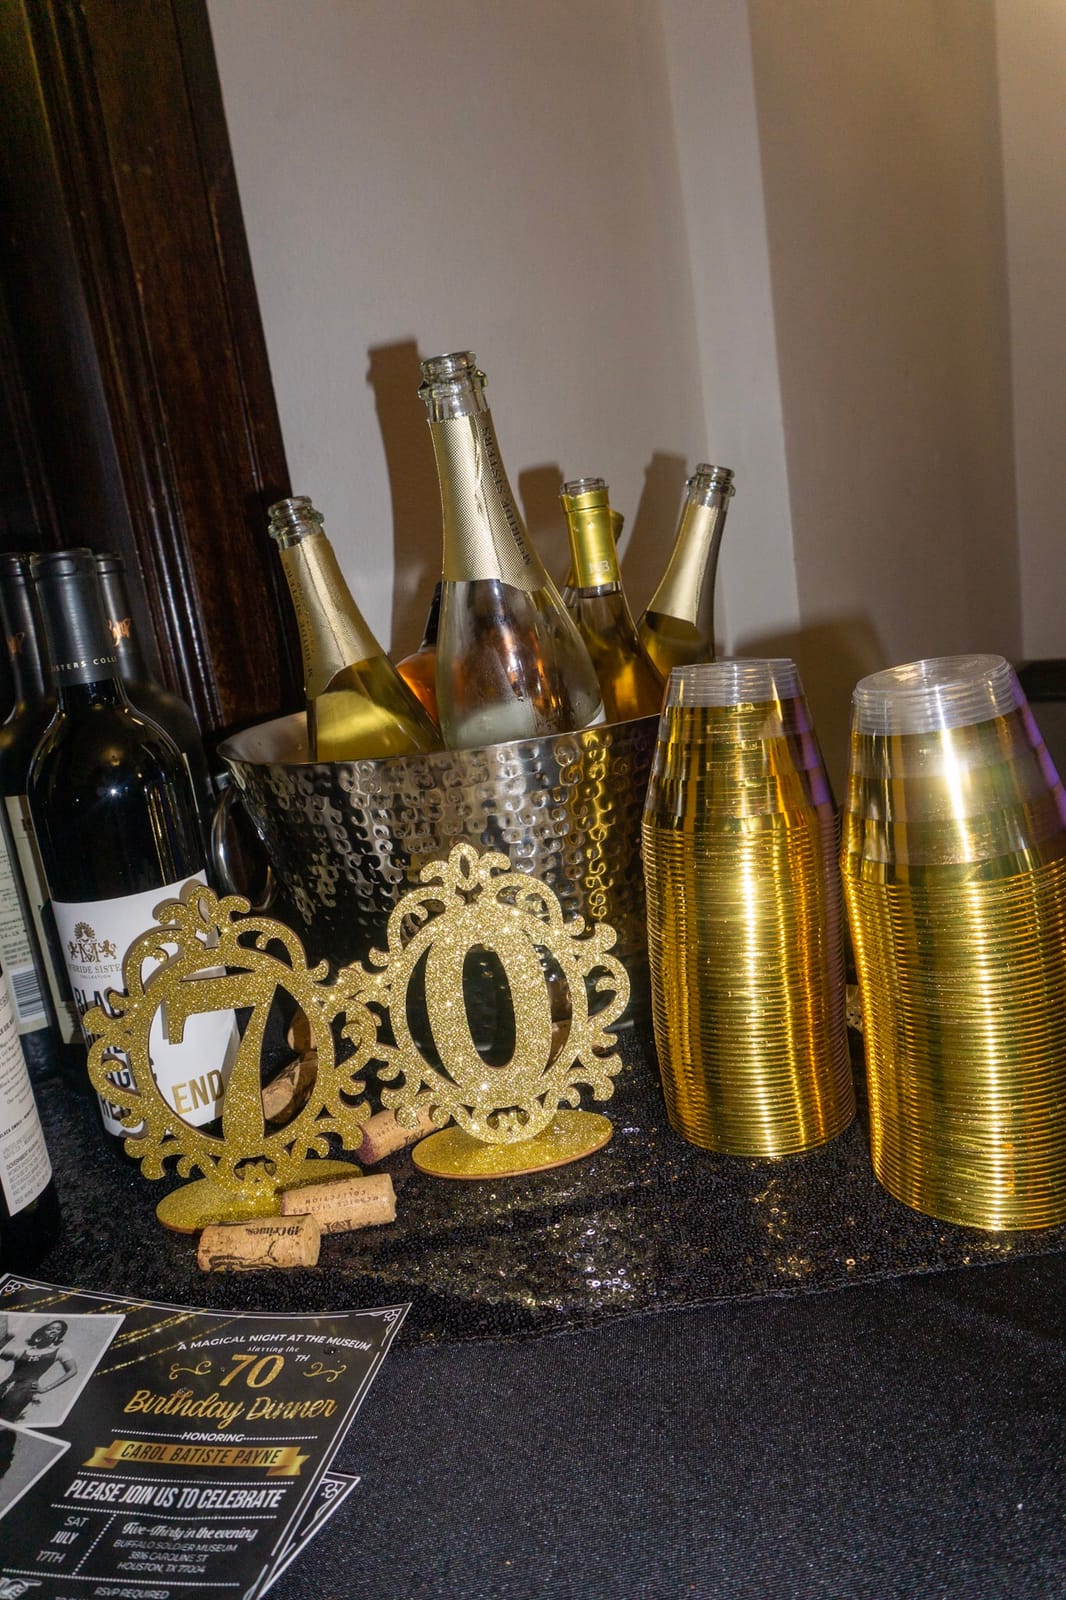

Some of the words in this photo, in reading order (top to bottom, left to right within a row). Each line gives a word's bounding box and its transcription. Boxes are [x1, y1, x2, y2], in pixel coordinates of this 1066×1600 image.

[51, 660, 87, 672] STERS
[94, 964, 122, 975] SISTE
[165, 970, 280, 1146] 7
[424, 930, 553, 1096] 0
[171, 1069, 226, 1115] END
[177, 1341, 188, 1352] A
[190, 1335, 246, 1349] MAGICAL
[249, 1333, 287, 1343] NIGHT
[289, 1333, 305, 1343] AT
[305, 1334, 327, 1344] THE
[326, 1335, 372, 1351] MUSEUM
[219, 1353, 285, 1389] 70
[294, 1353, 311, 1363] TH
[123, 1388, 246, 1430] Birthday
[245, 1396, 339, 1422] Dinner
[181, 1431, 245, 1443] HONORING
[120, 1443, 166, 1460] CAROL
[169, 1447, 229, 1464] BATISTE
[232, 1449, 283, 1465] PAYNE
[64, 1479, 122, 1503] PLEASE
[119, 1483, 155, 1504] JOIN
[154, 1486, 179, 1506] US
[177, 1488, 200, 1508] TO
[197, 1488, 287, 1509] CELEBRATE
[64, 1515, 90, 1528] SAT
[50, 1530, 79, 1545] JULY
[195, 1527, 214, 1539] the
[212, 1526, 259, 1542] evening
[112, 1539, 156, 1549] BUFFALO
[155, 1541, 196, 1552] SOLDIER
[195, 1543, 239, 1553] MUSEUM
[35, 1549, 67, 1564] 17TH
[148, 1551, 197, 1562] CAROLINE
[195, 1553, 209, 1562] ST
[165, 1563, 178, 1573] TX
[94, 1586, 120, 1597] RSVP
[119, 1588, 170, 1600] REQUIRED
